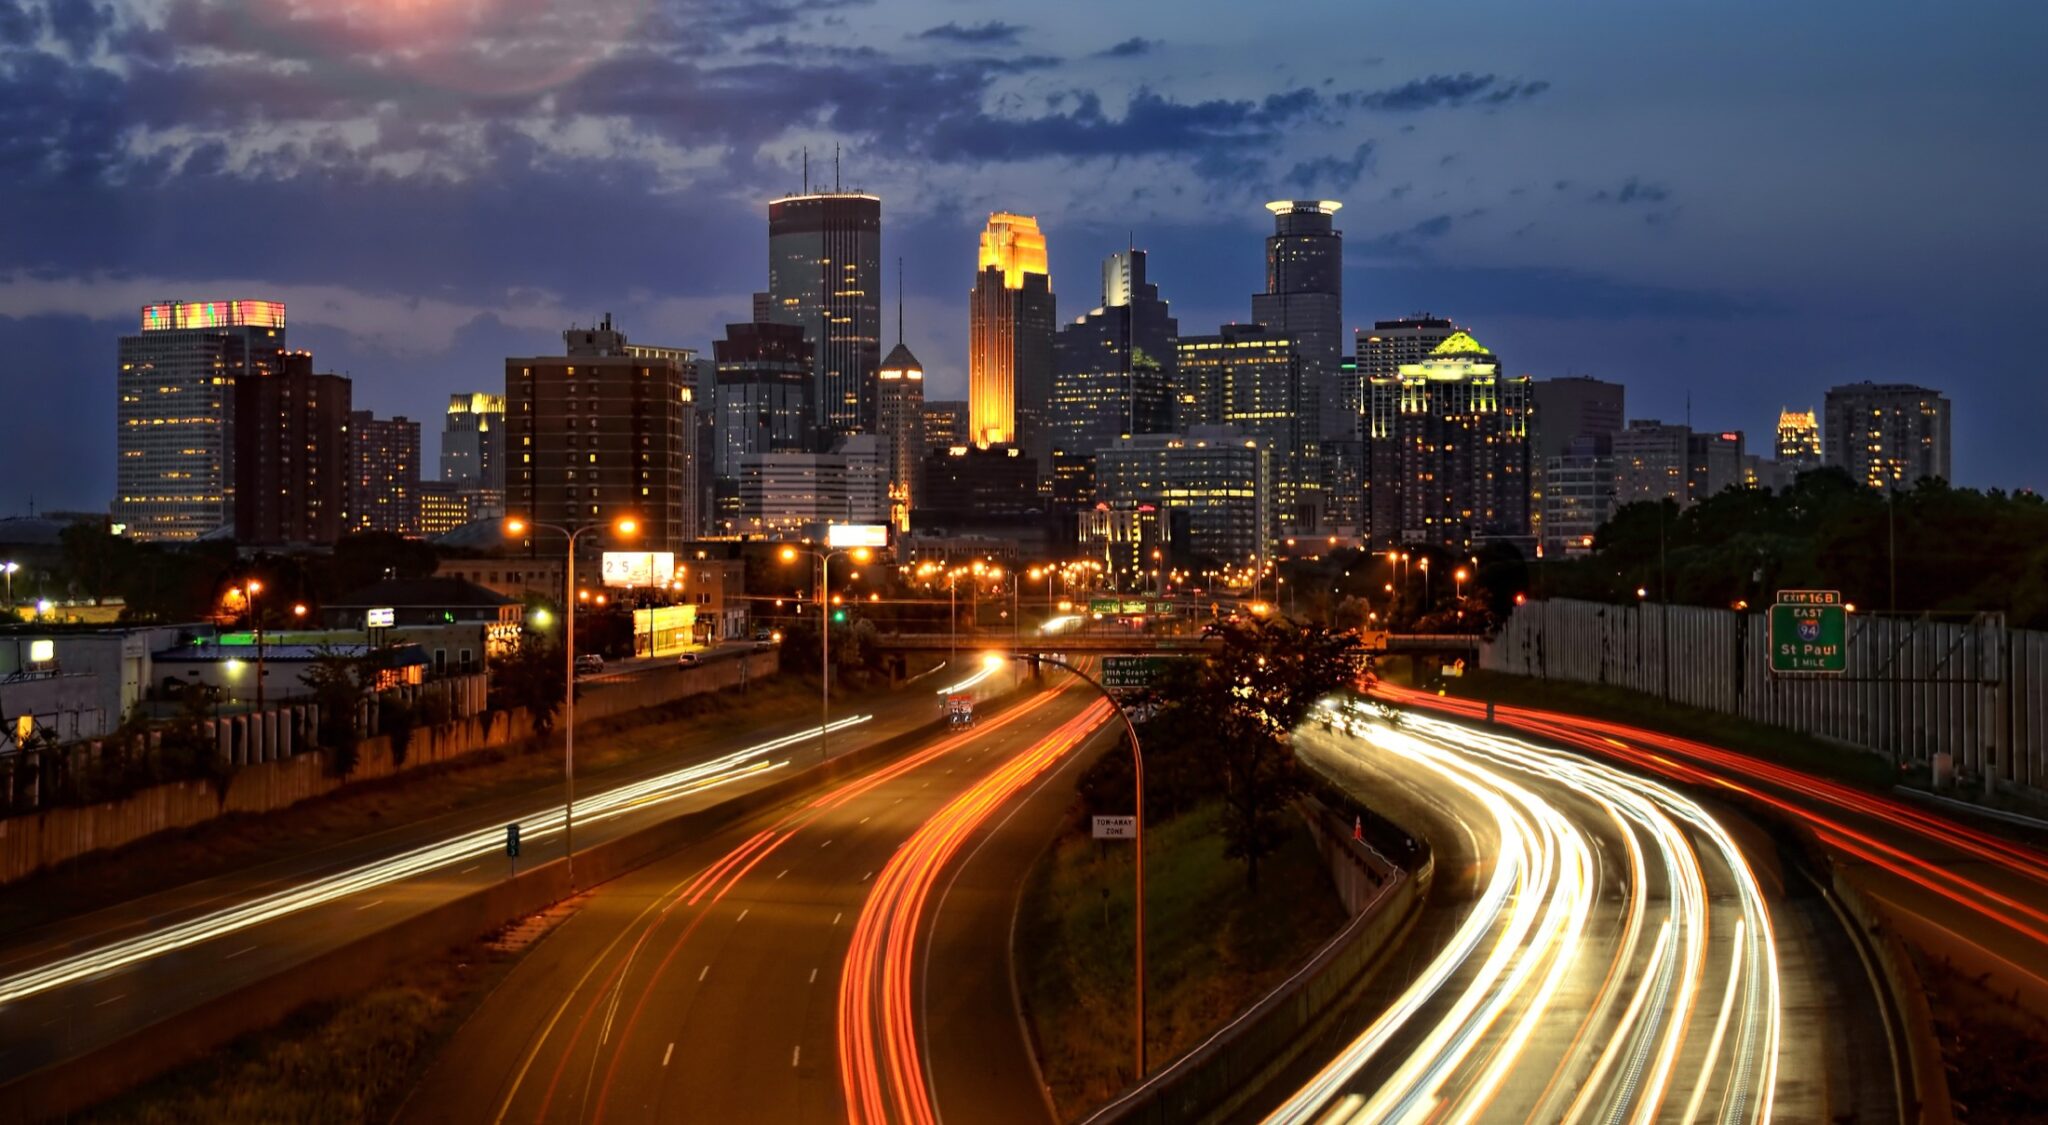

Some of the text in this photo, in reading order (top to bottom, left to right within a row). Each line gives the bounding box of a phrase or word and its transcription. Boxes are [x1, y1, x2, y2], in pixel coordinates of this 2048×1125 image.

[1783, 593, 1833, 603] EXIT 16B
[1794, 608, 1823, 617] EAST
[1801, 626, 1816, 636] 94
[1781, 644, 1836, 655] St Paul
[1793, 658, 1825, 667] 1 MILE
